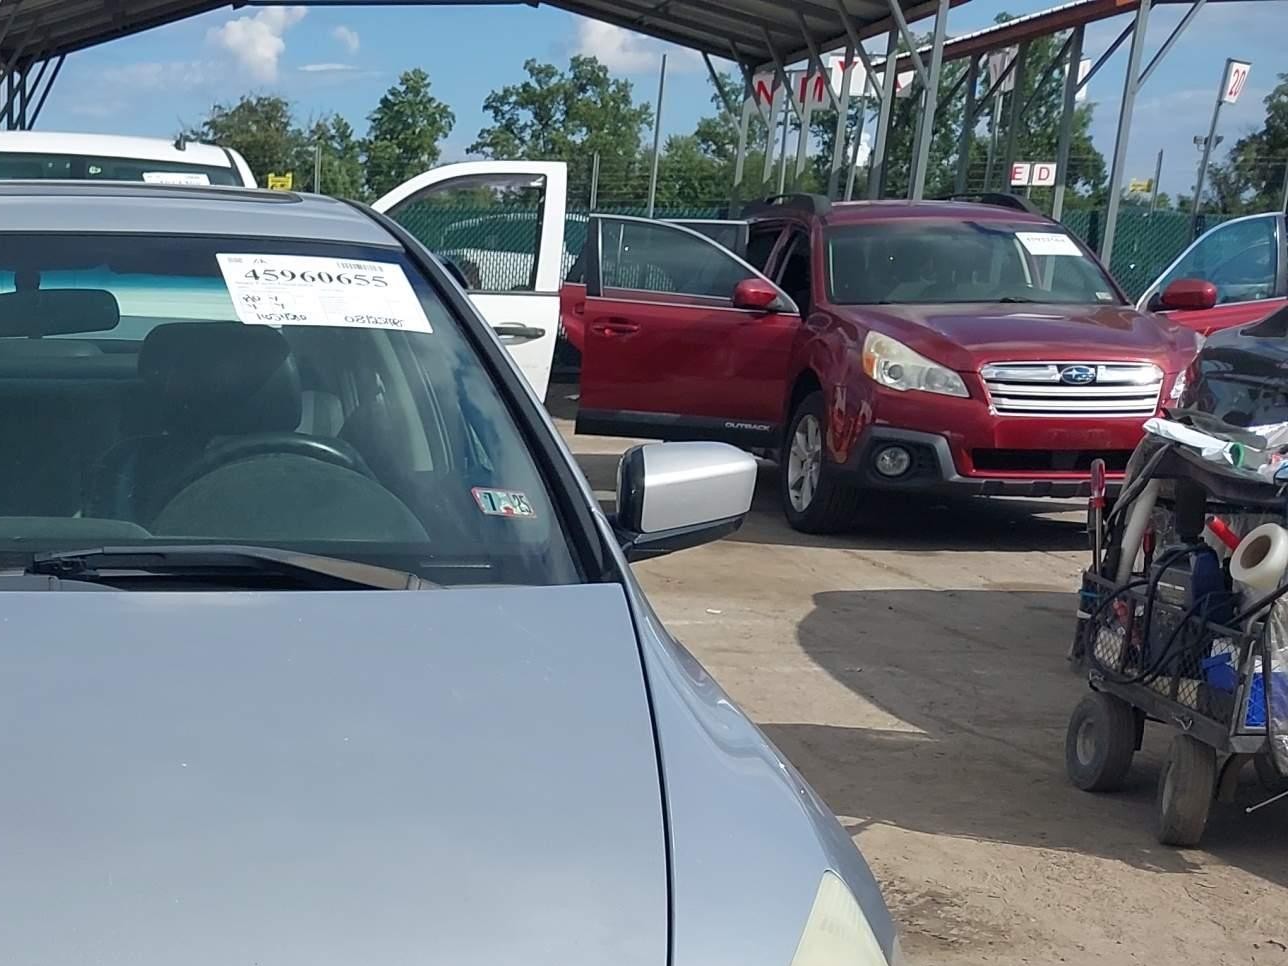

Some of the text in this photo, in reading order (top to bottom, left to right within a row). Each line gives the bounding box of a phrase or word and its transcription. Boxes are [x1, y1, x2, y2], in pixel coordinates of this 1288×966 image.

[1228, 68, 1246, 97] 20
[1011, 166, 1050, 181] E D
[244, 268, 389, 288] 45960655
[724, 421, 771, 432] OUTBACK
[512, 494, 532, 513] 25
